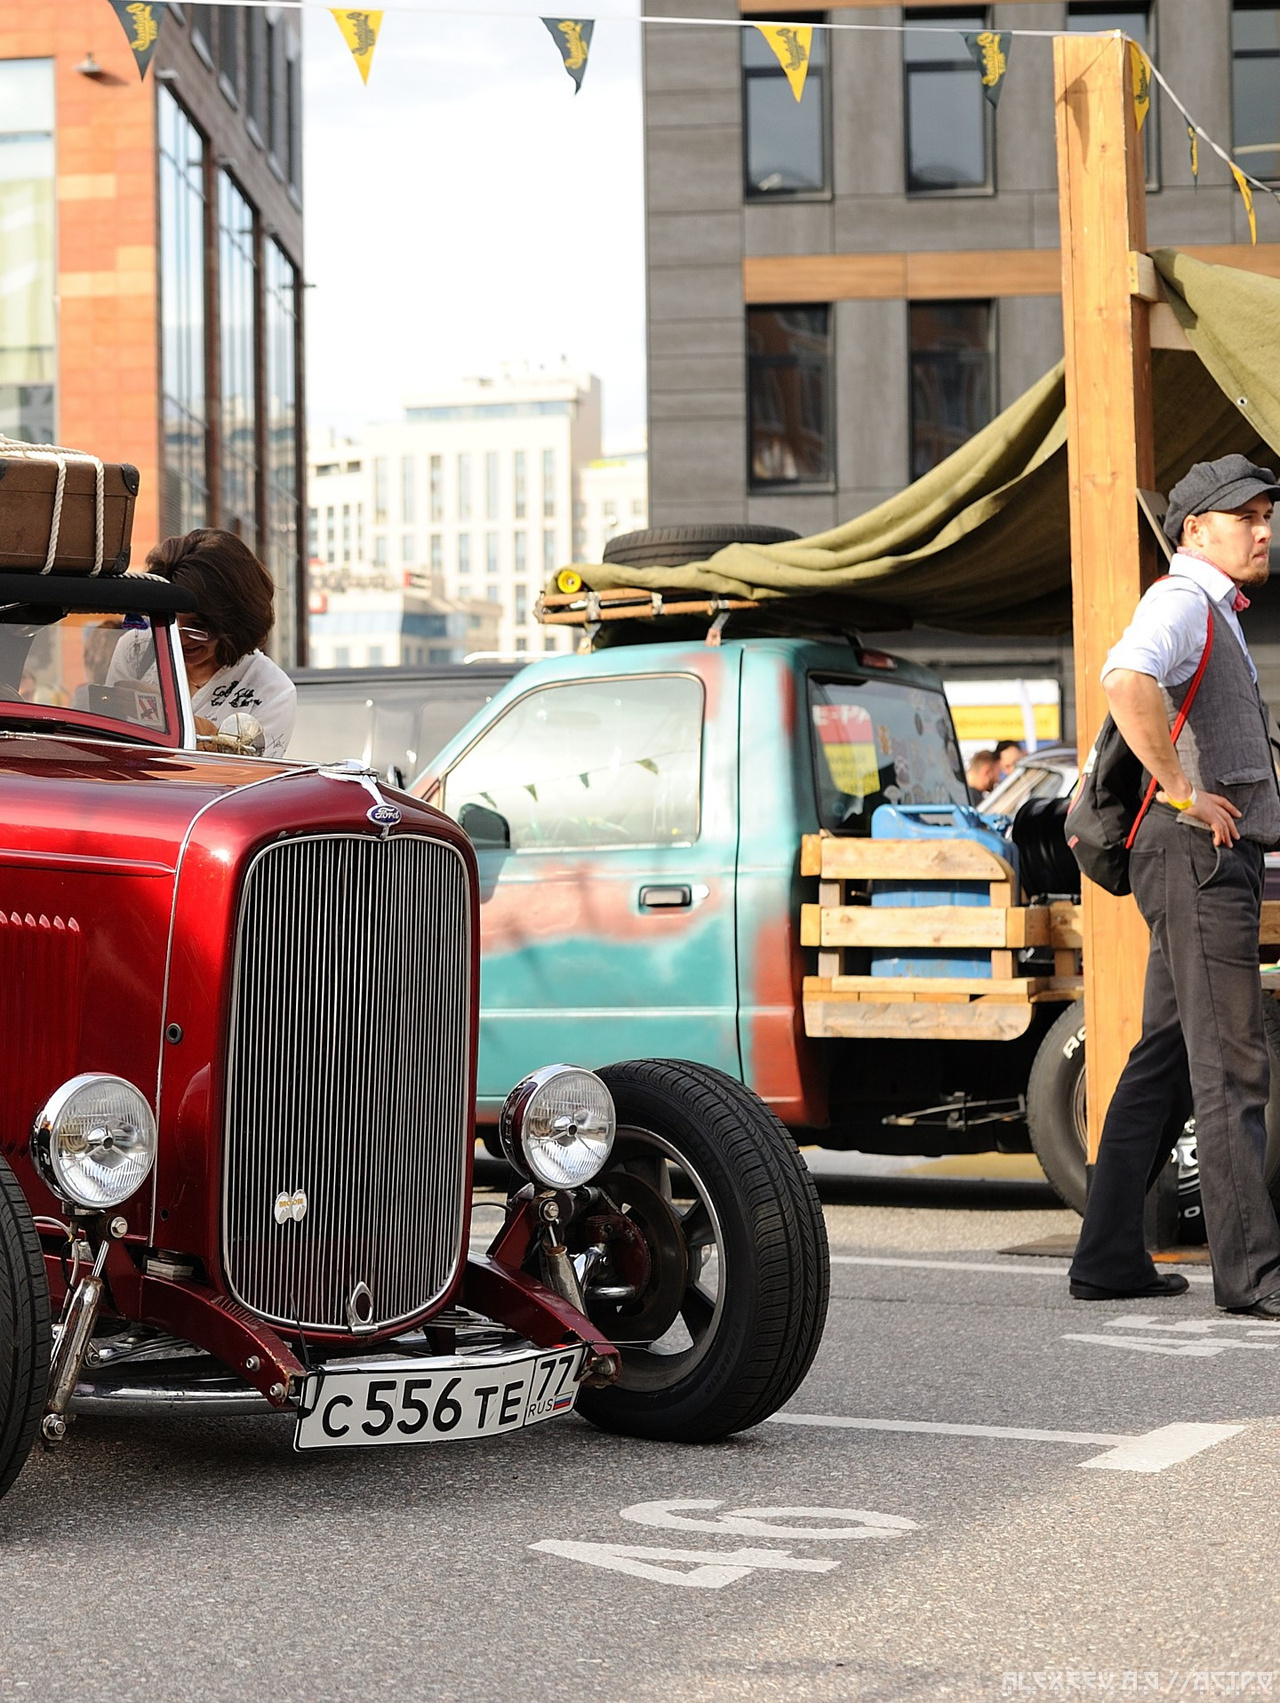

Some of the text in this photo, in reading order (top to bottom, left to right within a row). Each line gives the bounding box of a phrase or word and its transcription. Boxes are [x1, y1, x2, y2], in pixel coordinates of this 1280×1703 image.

[375, 806, 400, 820] Ford
[537, 1355, 575, 1401] 77
[528, 1401, 553, 1418] RUS
[526, 1498, 920, 1590] 46
